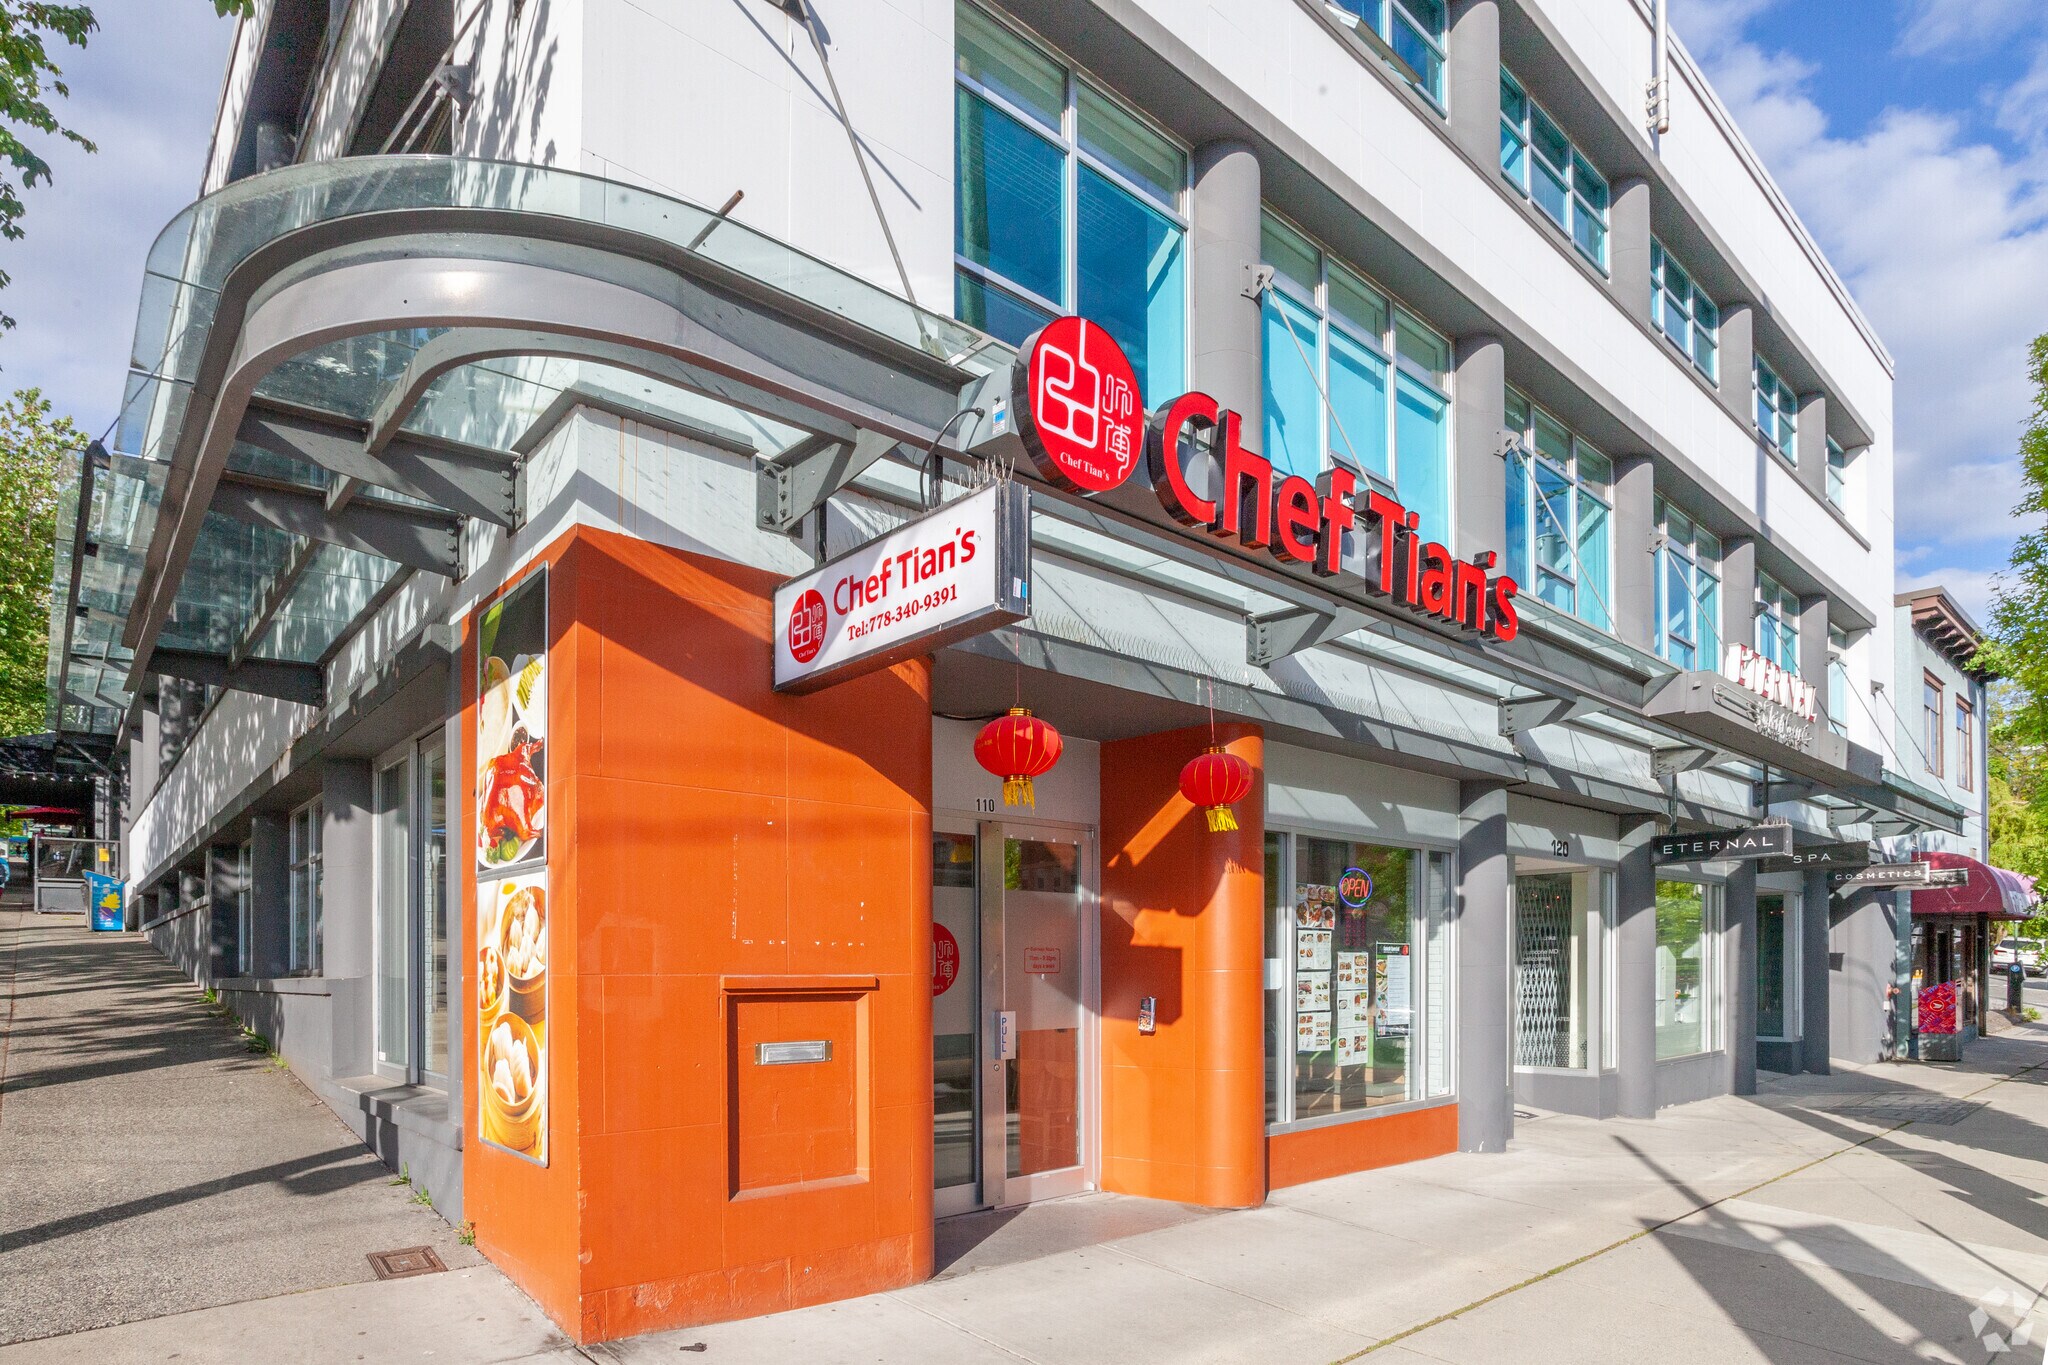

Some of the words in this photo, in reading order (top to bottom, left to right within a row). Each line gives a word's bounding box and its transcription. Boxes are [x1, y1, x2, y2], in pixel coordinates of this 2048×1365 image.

[1059, 451, 1082, 469] Chef
[1083, 459, 1110, 481] Tian's
[1150, 391, 1356, 577] Chef
[1356, 489, 1519, 643] Tian's
[833, 557, 893, 616] Chef
[897, 527, 976, 589] Tian's
[847, 584, 958, 642] Tel:778-340-9391
[1726, 642, 1817, 724] ETERNAL
[976, 798, 995, 812] 110
[1551, 840, 1569, 857] 120
[1663, 835, 1774, 855] ETERNAL
[1792, 852, 1832, 864] SPA
[1834, 868, 1922, 881] COSMETICS
[1341, 877, 1370, 898] OPEN
